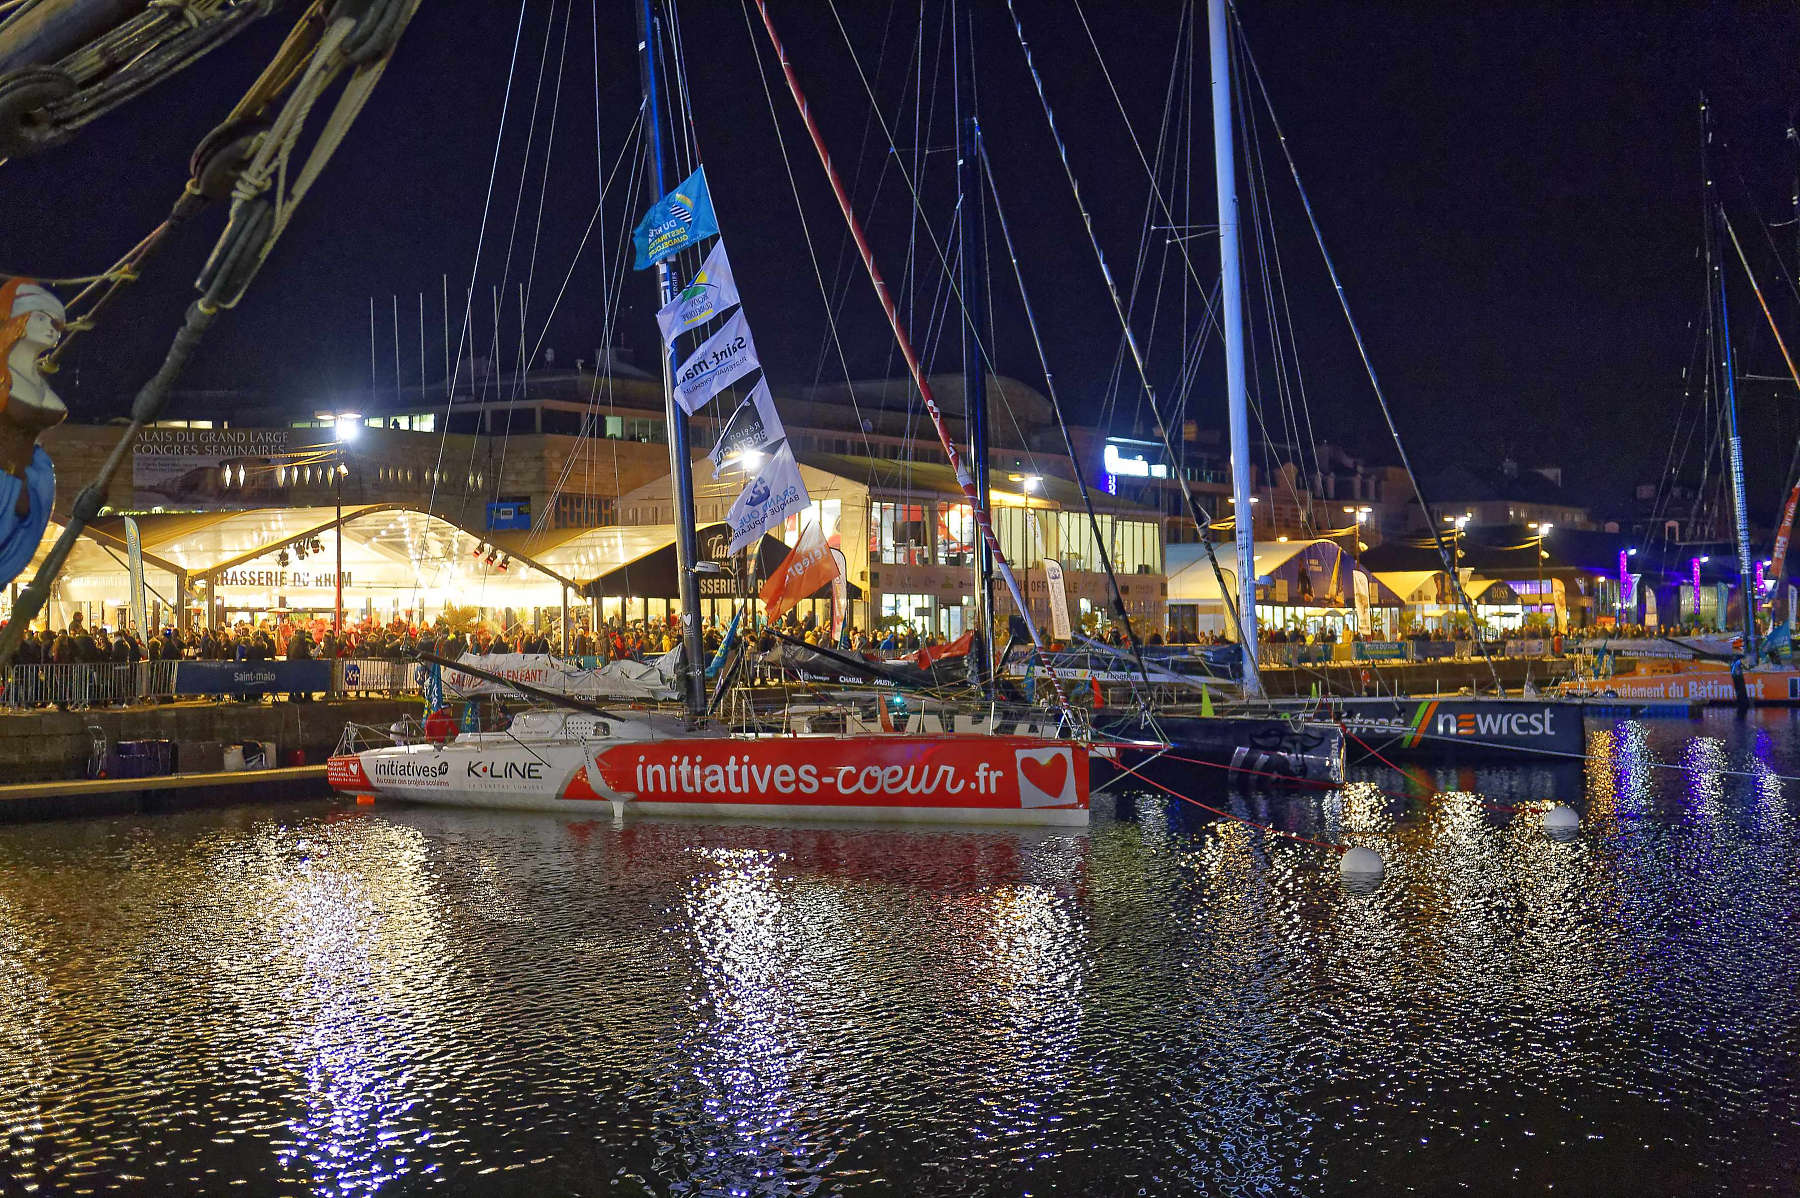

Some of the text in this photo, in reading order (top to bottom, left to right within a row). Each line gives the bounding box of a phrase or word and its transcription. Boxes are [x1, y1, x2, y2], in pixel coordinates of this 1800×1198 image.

[176, 432, 195, 442] DU
[199, 432, 246, 443] GRAND
[249, 432, 289, 443] LARGE
[1668, 681, 1684, 698] du
[1688, 679, 1765, 699] Bâtimnt
